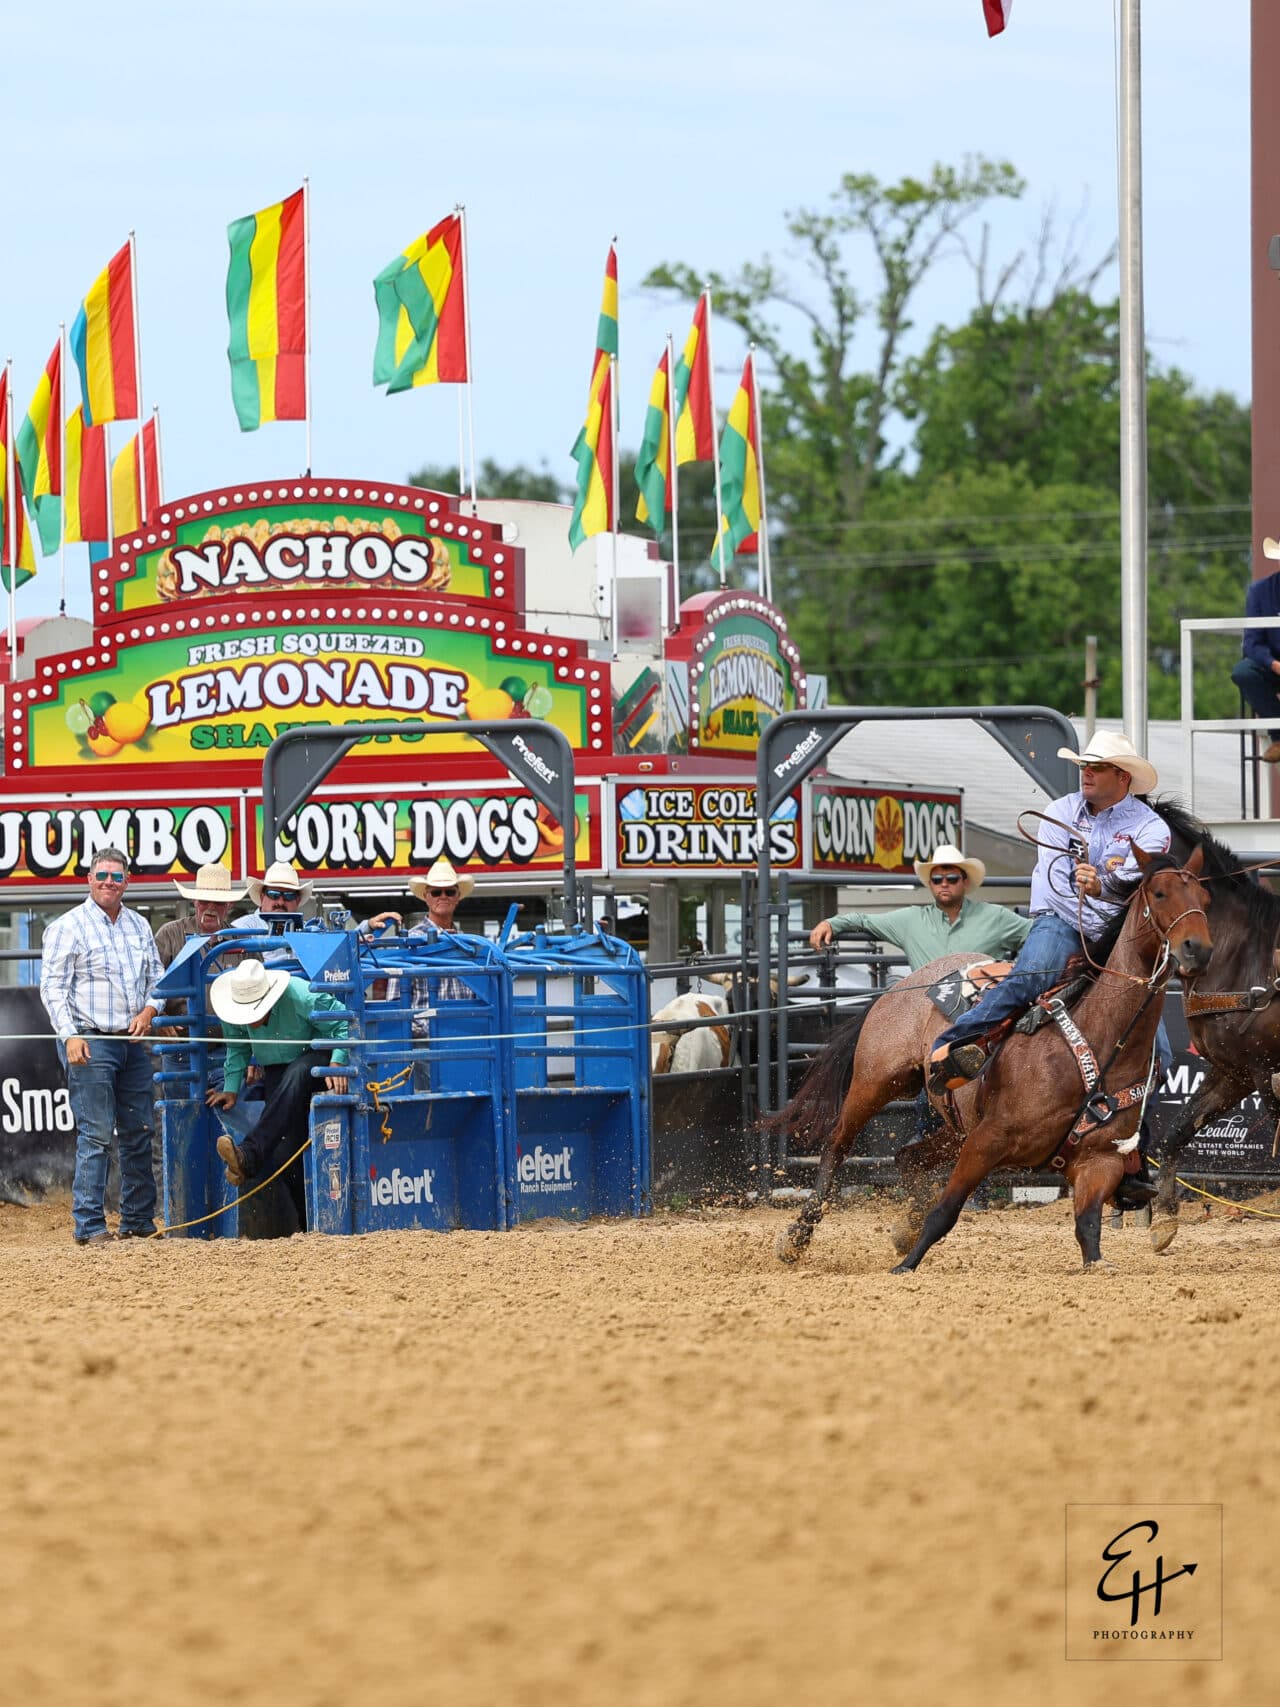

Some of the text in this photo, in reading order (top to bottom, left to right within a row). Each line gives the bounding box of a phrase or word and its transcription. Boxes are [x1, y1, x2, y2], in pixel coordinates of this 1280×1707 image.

[173, 535, 431, 593] NACHOS
[187, 633, 424, 666] FRESH SQUEEZED
[148, 658, 468, 727] LEMONADE
[709, 653, 784, 714] LEMONADE
[512, 735, 557, 782] Priefert
[774, 730, 820, 778] Priefert
[412, 798, 539, 861] DOGS
[647, 791, 760, 820] ICE COL
[817, 797, 958, 858] CORN DOGS
[623, 822, 798, 863] DRINKS
[1056, 1010, 1098, 1089] TRENT WAR
[1, 1077, 74, 1134] Sma
[520, 1181, 572, 1195] Ranch Equipment
